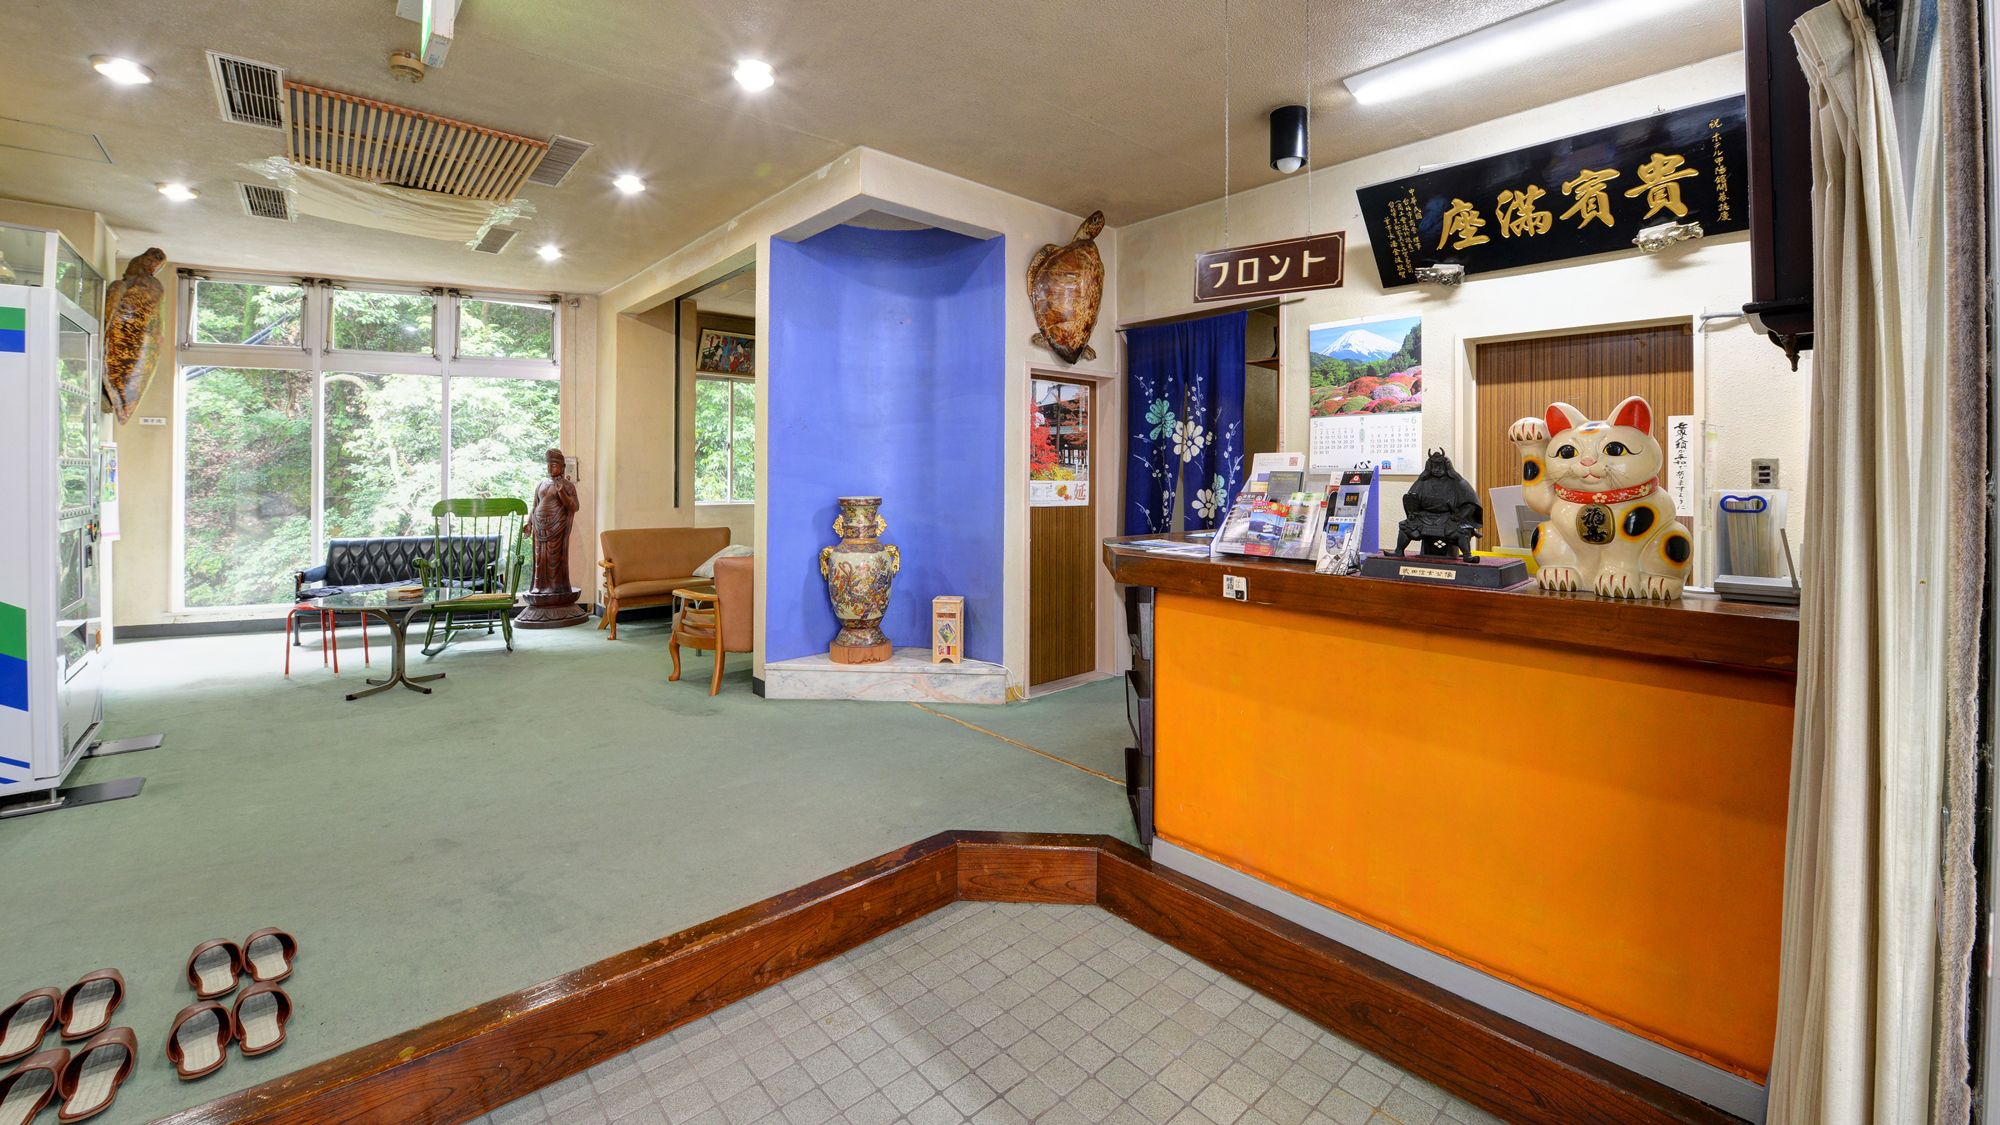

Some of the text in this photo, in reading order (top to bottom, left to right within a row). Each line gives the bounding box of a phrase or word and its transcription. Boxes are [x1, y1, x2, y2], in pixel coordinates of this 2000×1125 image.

[1209, 250, 1326, 289] フロント
[1411, 416, 1417, 424] 6
